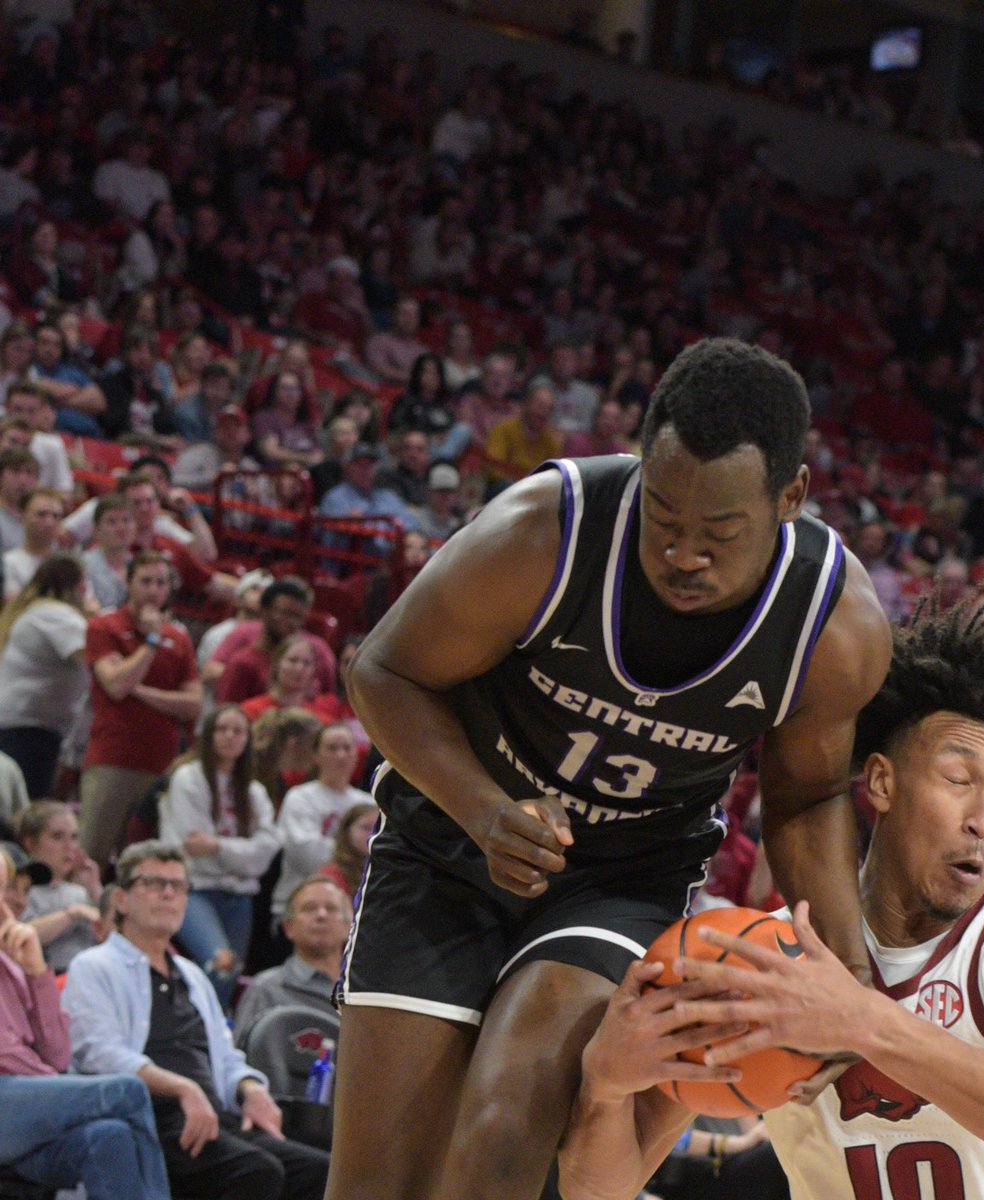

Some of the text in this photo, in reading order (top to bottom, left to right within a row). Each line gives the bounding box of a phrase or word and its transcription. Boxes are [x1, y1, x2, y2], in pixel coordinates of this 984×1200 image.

[527, 665, 738, 753] CENTRAL
[556, 731, 658, 799] 13
[915, 982, 964, 1028] SEC
